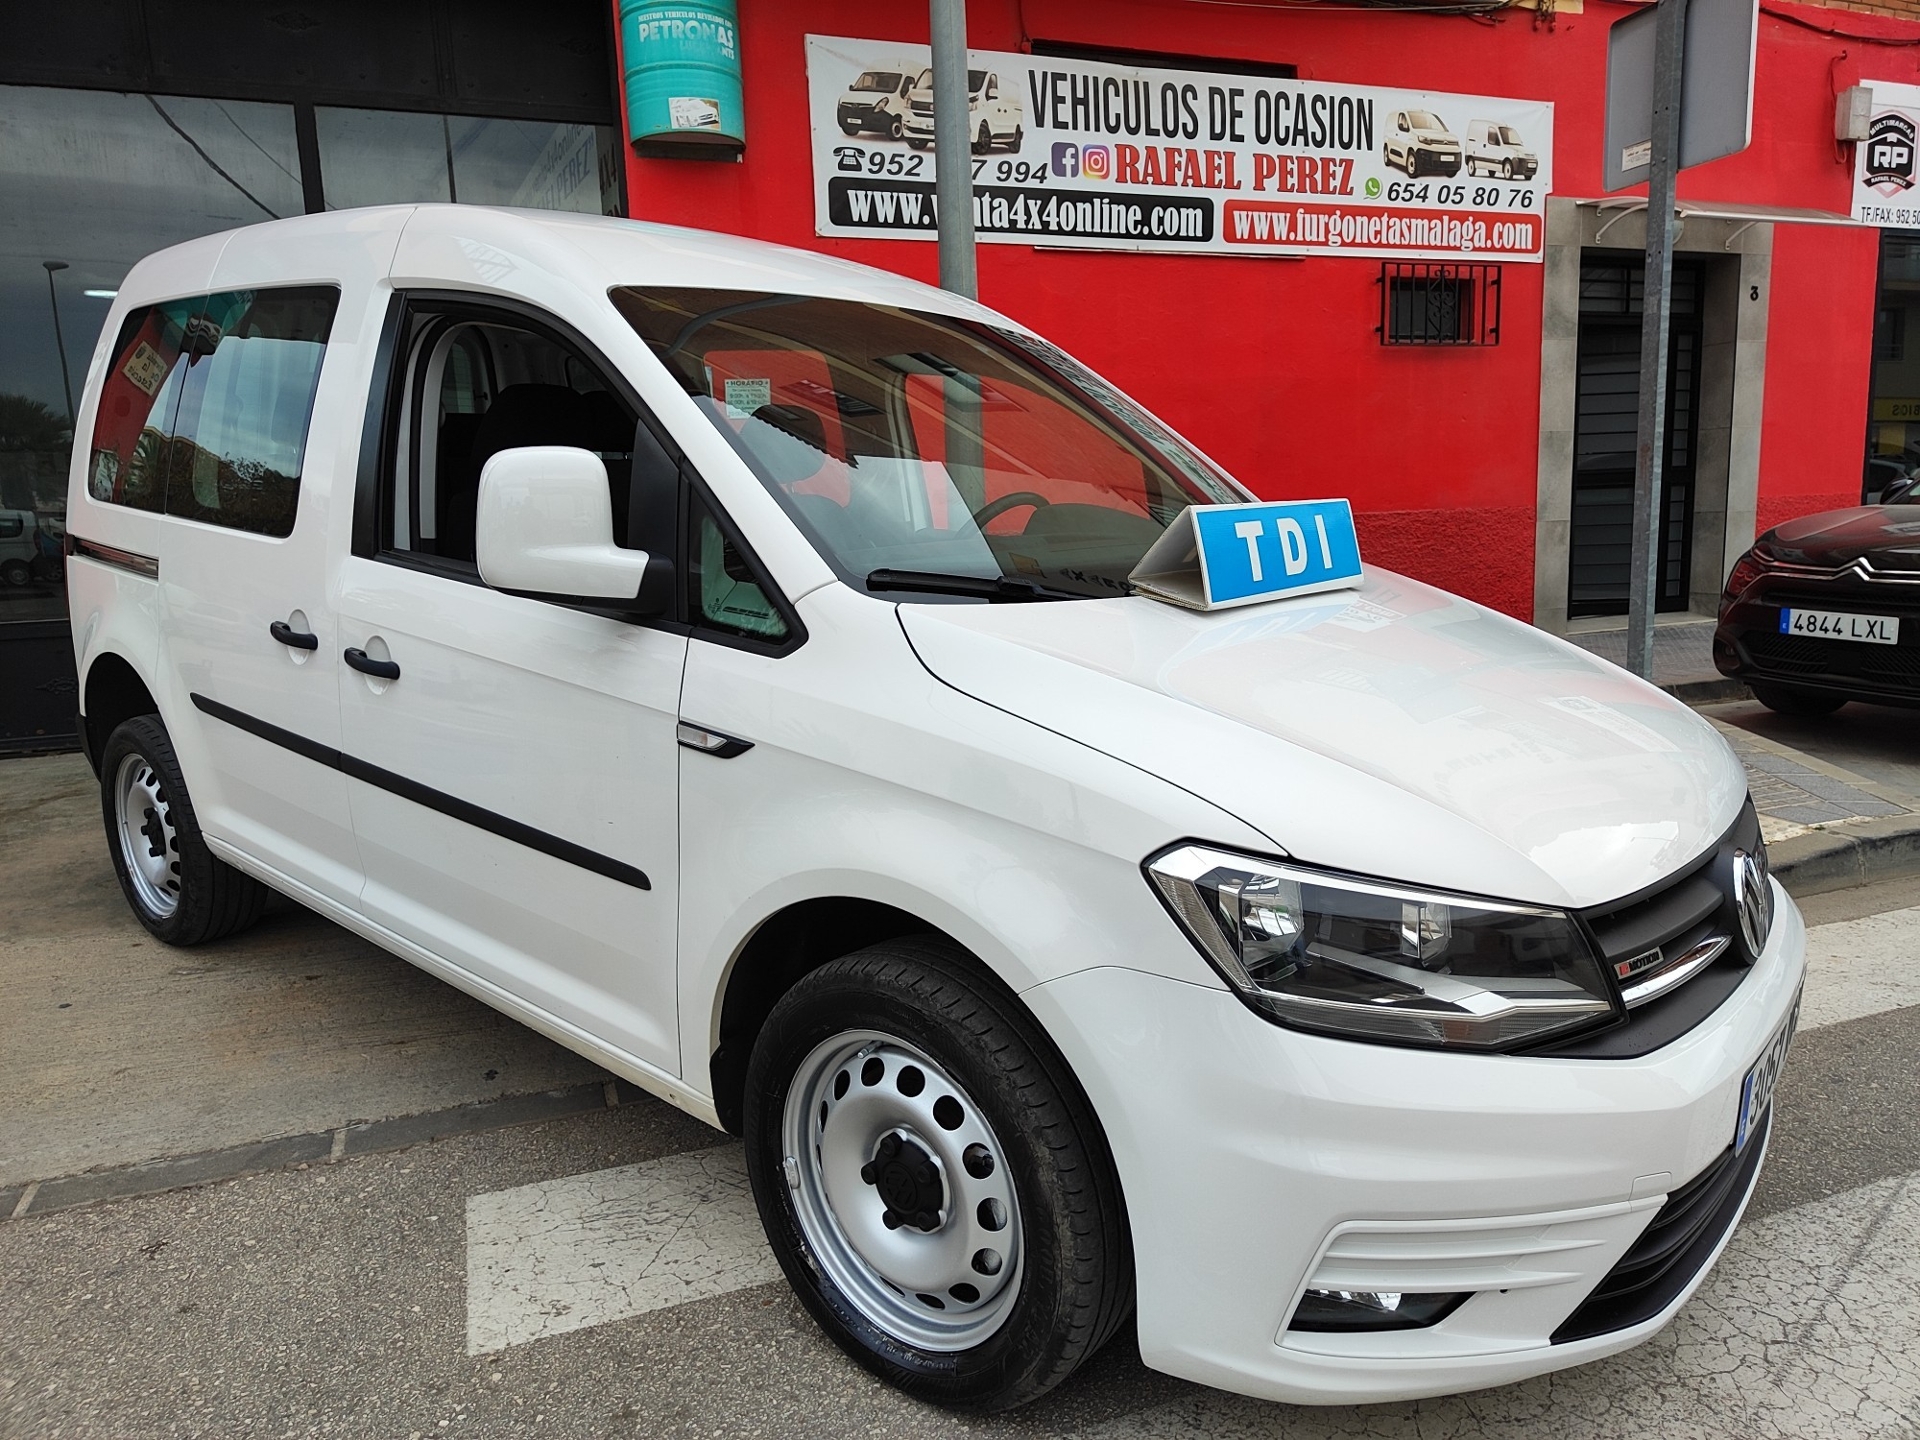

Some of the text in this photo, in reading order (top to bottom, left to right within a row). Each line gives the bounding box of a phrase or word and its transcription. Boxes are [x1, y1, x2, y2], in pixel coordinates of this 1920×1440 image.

[638, 20, 734, 48] PETRONAS
[1028, 70, 1373, 151] VEHICULOS DE OCASION
[1870, 120, 1914, 139] MULTIMARCAS
[867, 152, 924, 177] 952
[996, 160, 1048, 184] 994
[1114, 144, 1354, 196] RAFAEL PEREZ
[1874, 145, 1908, 168] RP
[1388, 182, 1534, 208] 654 05 80 76
[1871, 176, 1907, 187] RAFAEL PEREZ
[847, 190, 1202, 237] www.ta4x4online.com
[1233, 208, 1532, 251] www.furgonetasmalaga.com
[1234, 514, 1333, 582] TDI
[1794, 614, 1843, 636] 4844
[1852, 618, 1891, 640] LXL
